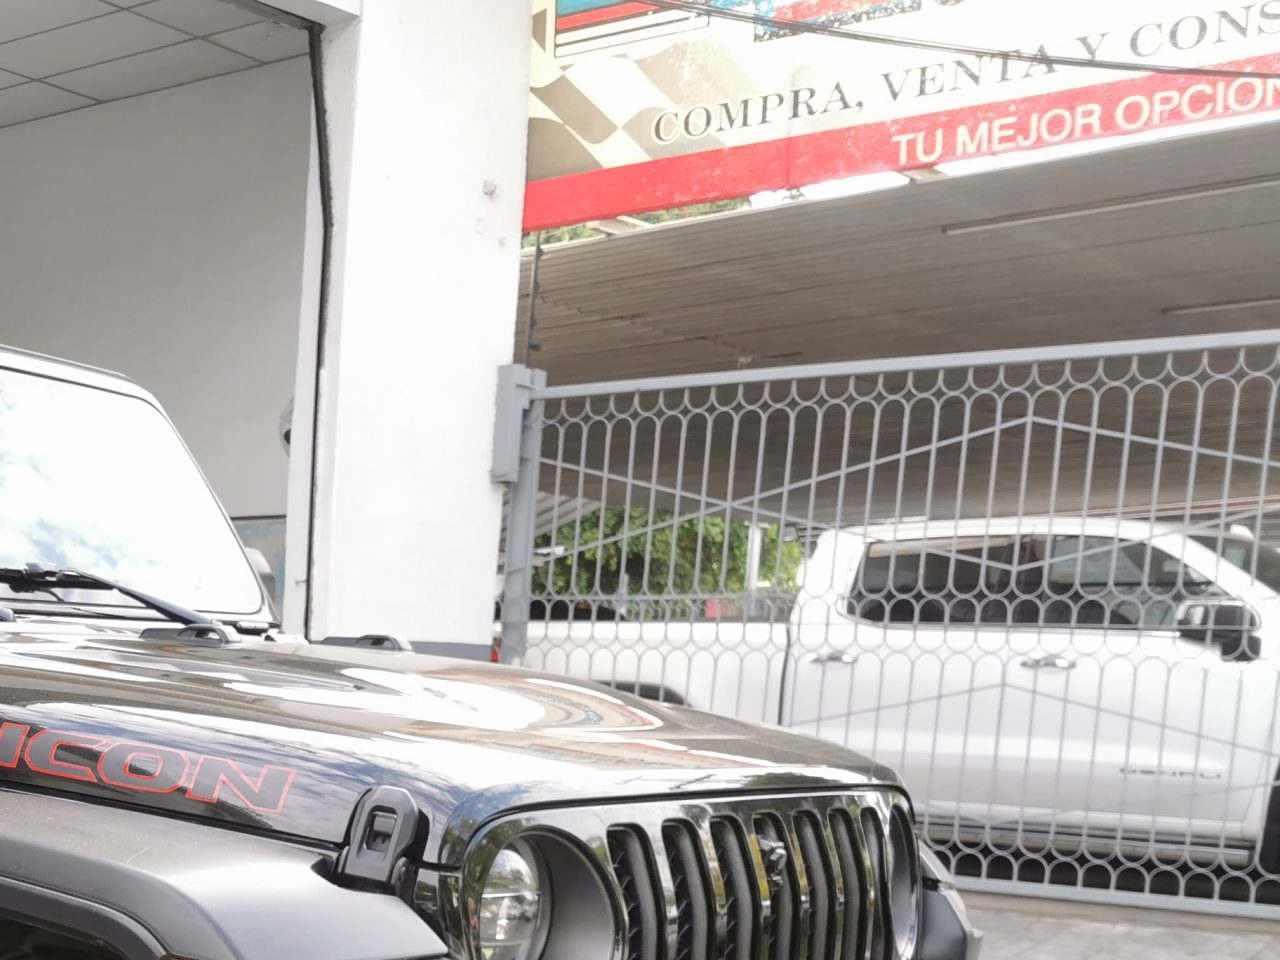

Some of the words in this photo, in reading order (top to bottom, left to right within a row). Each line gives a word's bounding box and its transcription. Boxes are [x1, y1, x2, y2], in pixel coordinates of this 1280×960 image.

[653, 81, 864, 142] COMPRA,
[881, 43, 1058, 101] VENTA
[1075, 31, 1110, 65] Y
[892, 127, 943, 166] TU
[956, 103, 1103, 155] MEJOR
